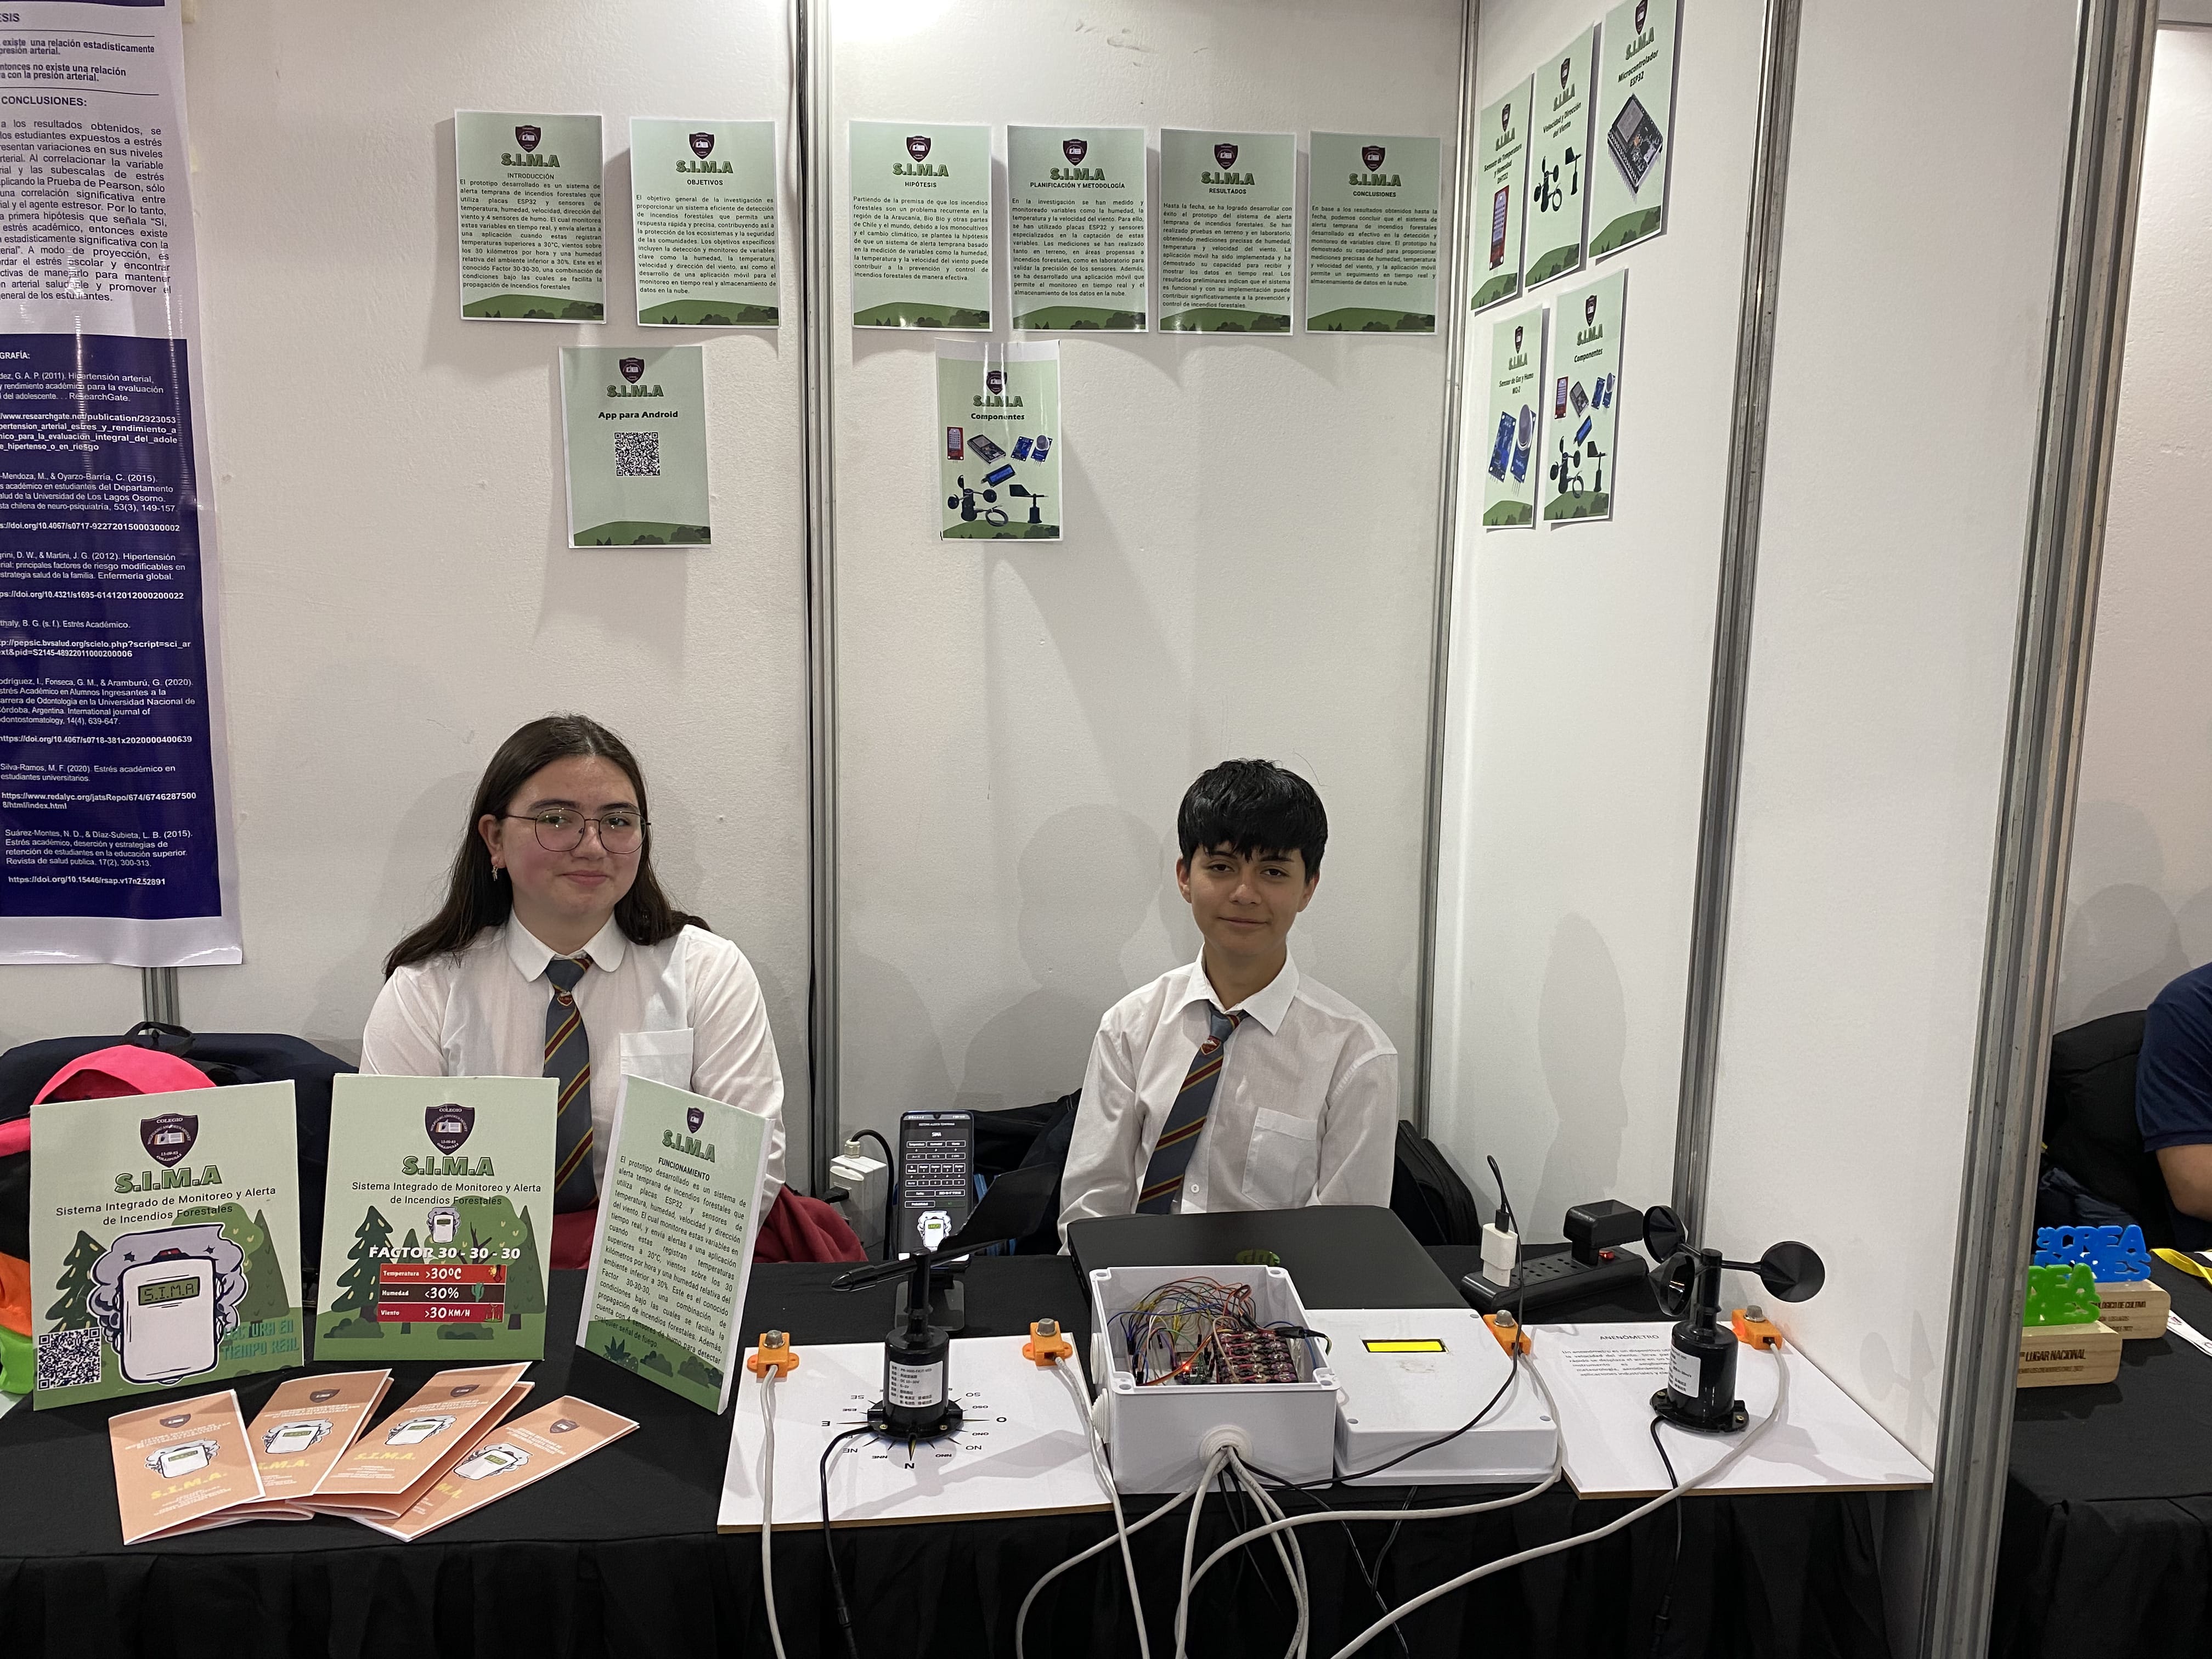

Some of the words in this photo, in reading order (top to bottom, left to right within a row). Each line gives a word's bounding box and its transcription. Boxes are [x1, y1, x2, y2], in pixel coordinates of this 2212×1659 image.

[48, 39, 81, 48] relación
[83, 41, 155, 53] estadísticamente
[1618, 49, 1658, 82] Microcontrolador
[1630, 71, 1644, 87] ESP32
[2, 97, 87, 106] CONCLUSIONES:
[14, 120, 26, 128] los
[34, 120, 82, 129] resultados
[91, 122, 143, 135] obtenidos,
[501, 153, 560, 168] S.I.M.A
[675, 160, 733, 174] S.I.M.A
[507, 172, 554, 180] INTRODUCCIÓN
[893, 163, 949, 177] S.I.M.A
[1049, 168, 1105, 180] S.I.M.A
[1201, 171, 1255, 185] S.I.M.A
[1348, 173, 1402, 187] S.I.M.A
[3, 223, 27, 232] estrés
[32, 223, 82, 233] académico,
[88, 225, 134, 236] entonces
[140, 229, 168, 238] existe
[1574, 348, 1602, 363] Componentes
[607, 385, 664, 397] S.I.M.A
[973, 395, 1024, 407] S.I.M.A
[1, 764, 47, 772] Silva-Ramos,
[67, 764, 91, 773] (2020).
[5, 830, 62, 838] Suárez-Montes,
[92, 831, 140, 840] Díaz-Subieta,
[164, 830, 193, 839] (2015).
[662, 1130, 715, 1163] S.I.M.A
[402, 1156, 494, 1177] S.I.M.A
[658, 1157, 710, 1181] FUNCIONAMIENTO
[114, 1165, 222, 1194] S.I.M.A
[629, 1160, 652, 1173] prototipo
[656, 1169, 690, 1187] desarrollado
[714, 1190, 736, 1204] sistema
[739, 1199, 747, 1207] de
[352, 1182, 390, 1190] Sistema
[393, 1182, 438, 1193] Integrado
[441, 1182, 453, 1190] de
[456, 1183, 503, 1192] Monitoreo
[514, 1183, 541, 1192] Alerta
[56, 1204, 101, 1216] Sistema
[106, 1198, 160, 1212] Integrado
[162, 1197, 175, 1205] de
[179, 1192, 233, 1204] Monitoreo
[236, 1192, 242, 1200] y
[245, 1187, 276, 1197] Alerta
[390, 1195, 403, 1204] de
[404, 1195, 450, 1204] Incendios
[453, 1196, 502, 1205] Forestales
[103, 1216, 116, 1226] de
[120, 1211, 173, 1224] Incendios
[177, 1205, 233, 1218] Forestales
[369, 1245, 433, 1259] FACTOR
[438, 1247, 458, 1259] 30
[470, 1248, 489, 1259] 30
[501, 1248, 521, 1260] 30
[144, 1283, 195, 1302] S.I.M.A
[425, 1287, 459, 1300] <30%
[425, 1306, 447, 1319] >30
[448, 1308, 470, 1317] KM/H
[223, 1322, 275, 1341] LECTURA
[272, 1338, 300, 1354] REAL
[2025, 1351, 2049, 1362] LUGAR
[151, 1472, 228, 1500] S.I.M.A.
